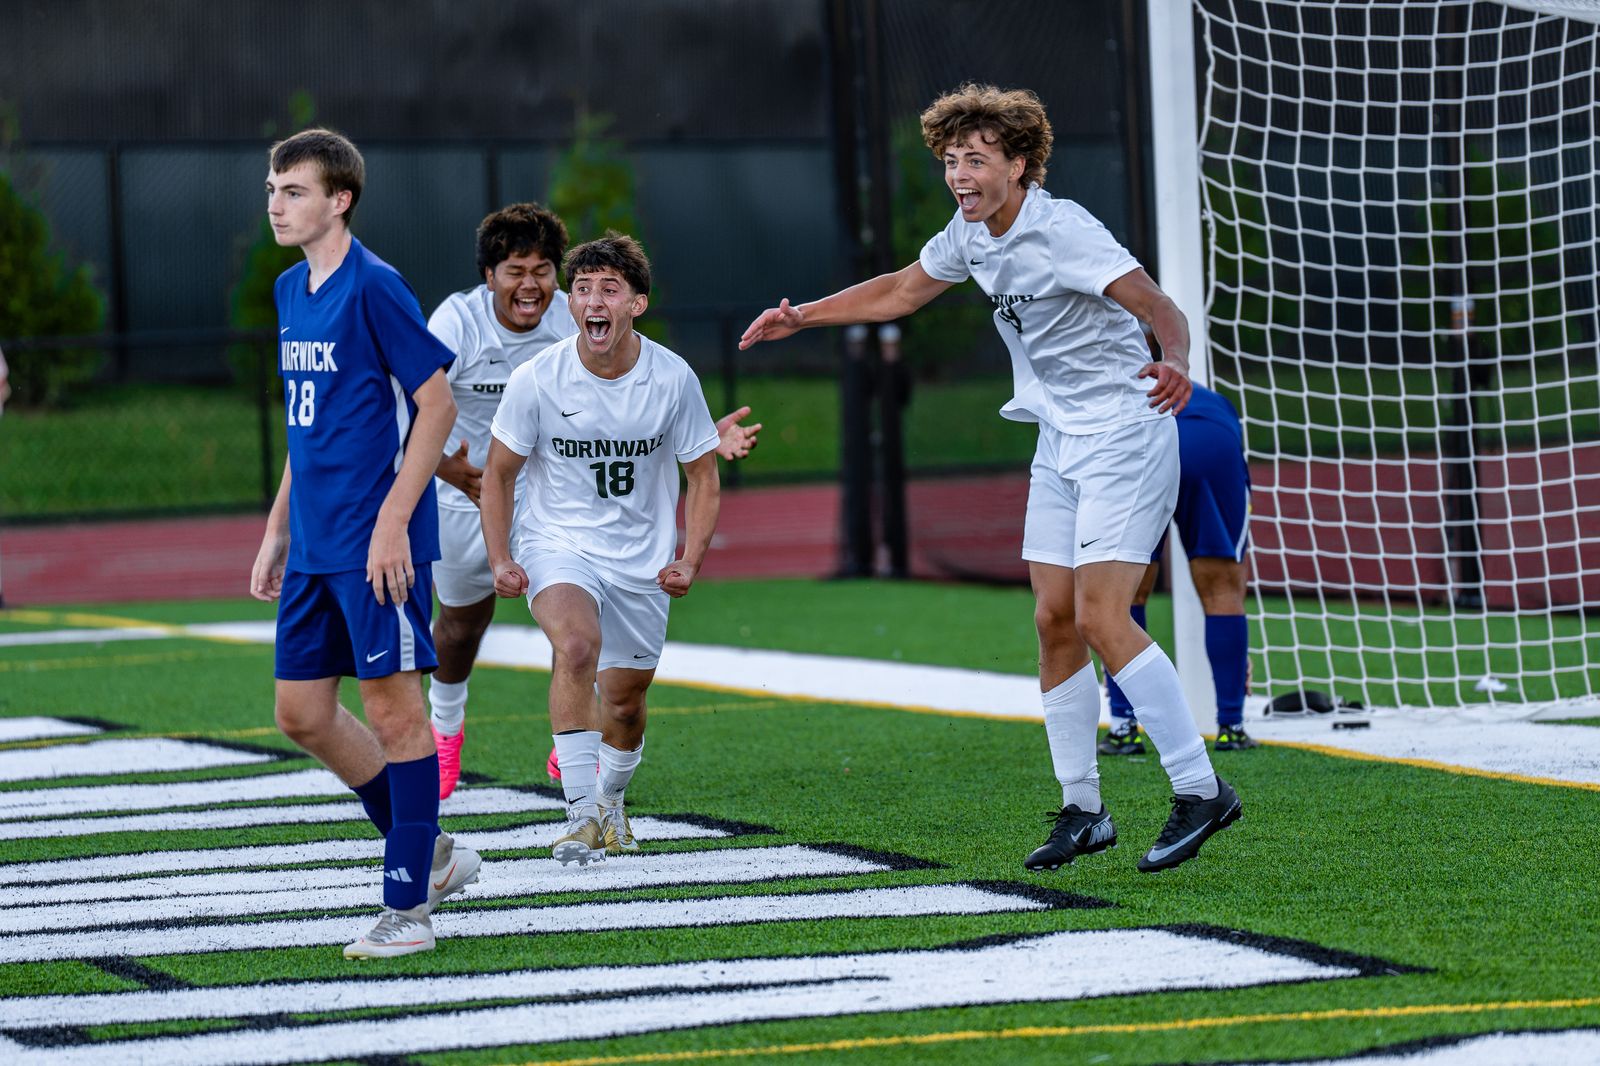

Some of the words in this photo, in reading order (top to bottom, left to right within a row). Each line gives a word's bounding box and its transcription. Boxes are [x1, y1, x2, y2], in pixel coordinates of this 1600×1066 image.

[287, 379, 315, 427] 28
[551, 433, 664, 458] CORNWALL
[589, 460, 635, 499] 18
